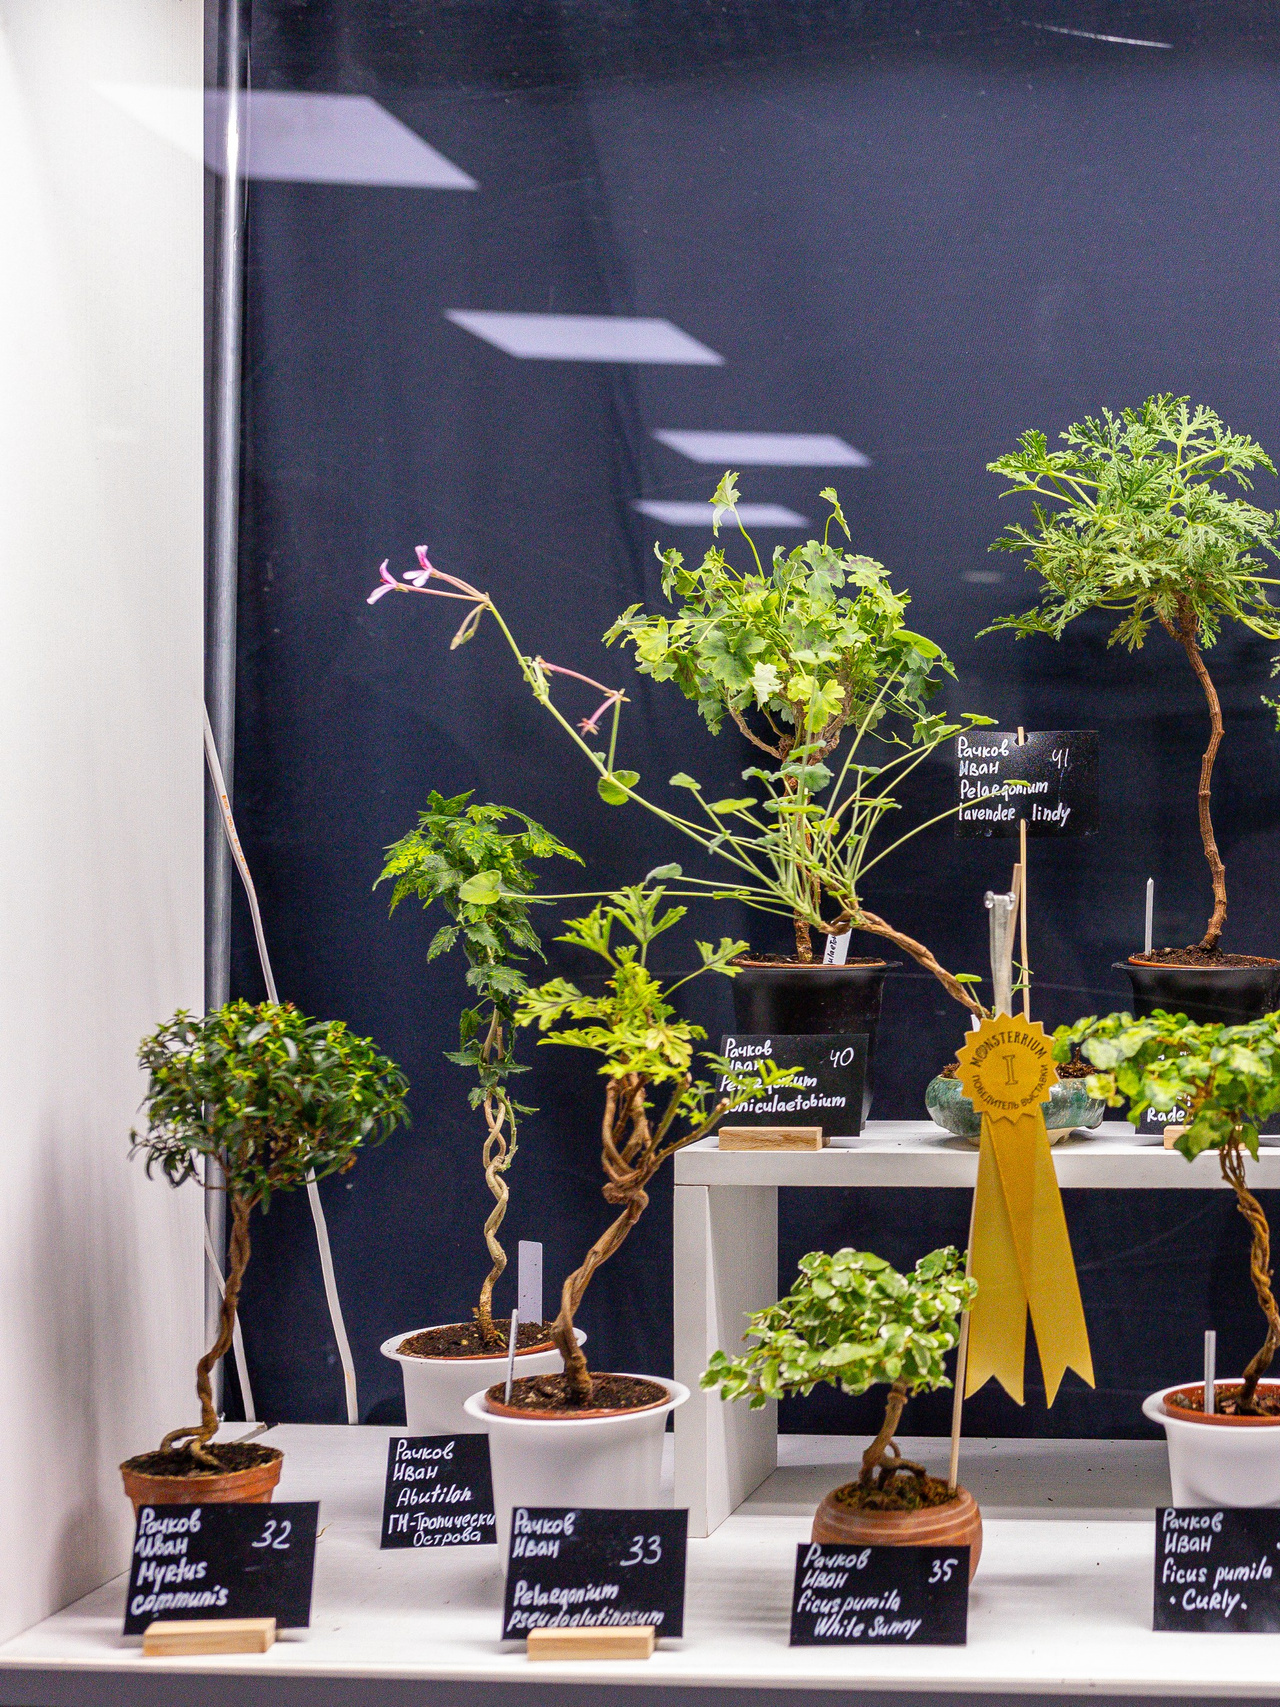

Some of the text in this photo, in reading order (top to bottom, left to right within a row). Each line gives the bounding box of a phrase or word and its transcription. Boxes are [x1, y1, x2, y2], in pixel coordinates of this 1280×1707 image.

[957, 736, 1010, 758] Рачков
[1051, 748, 1069, 769] 41
[958, 760, 999, 777] Иван
[1032, 802, 1071, 827] lindy
[724, 1037, 773, 1059] Рачков
[829, 1047, 855, 1068] 40
[970, 1030, 1048, 1068] MONSTERRIUM
[972, 1073, 1020, 1111] ПОБЕДИТЕЛЬ
[395, 1439, 455, 1461] Рачков
[393, 1462, 439, 1481] Иван
[395, 1483, 473, 1508] Abutilon
[138, 1508, 202, 1536] Рачков
[513, 1508, 576, 1536] Рачков
[1162, 1507, 1225, 1533] Рачков
[251, 1519, 292, 1549] 32
[412, 1526, 482, 1547] Острова
[1163, 1532, 1213, 1554] Иван
[511, 1536, 561, 1559] Иван
[619, 1534, 663, 1567] 33
[802, 1541, 872, 1571] Рачков
[927, 1558, 959, 1584] 35
[1213, 1555, 1274, 1591] pumila
[813, 1614, 866, 1639] White
